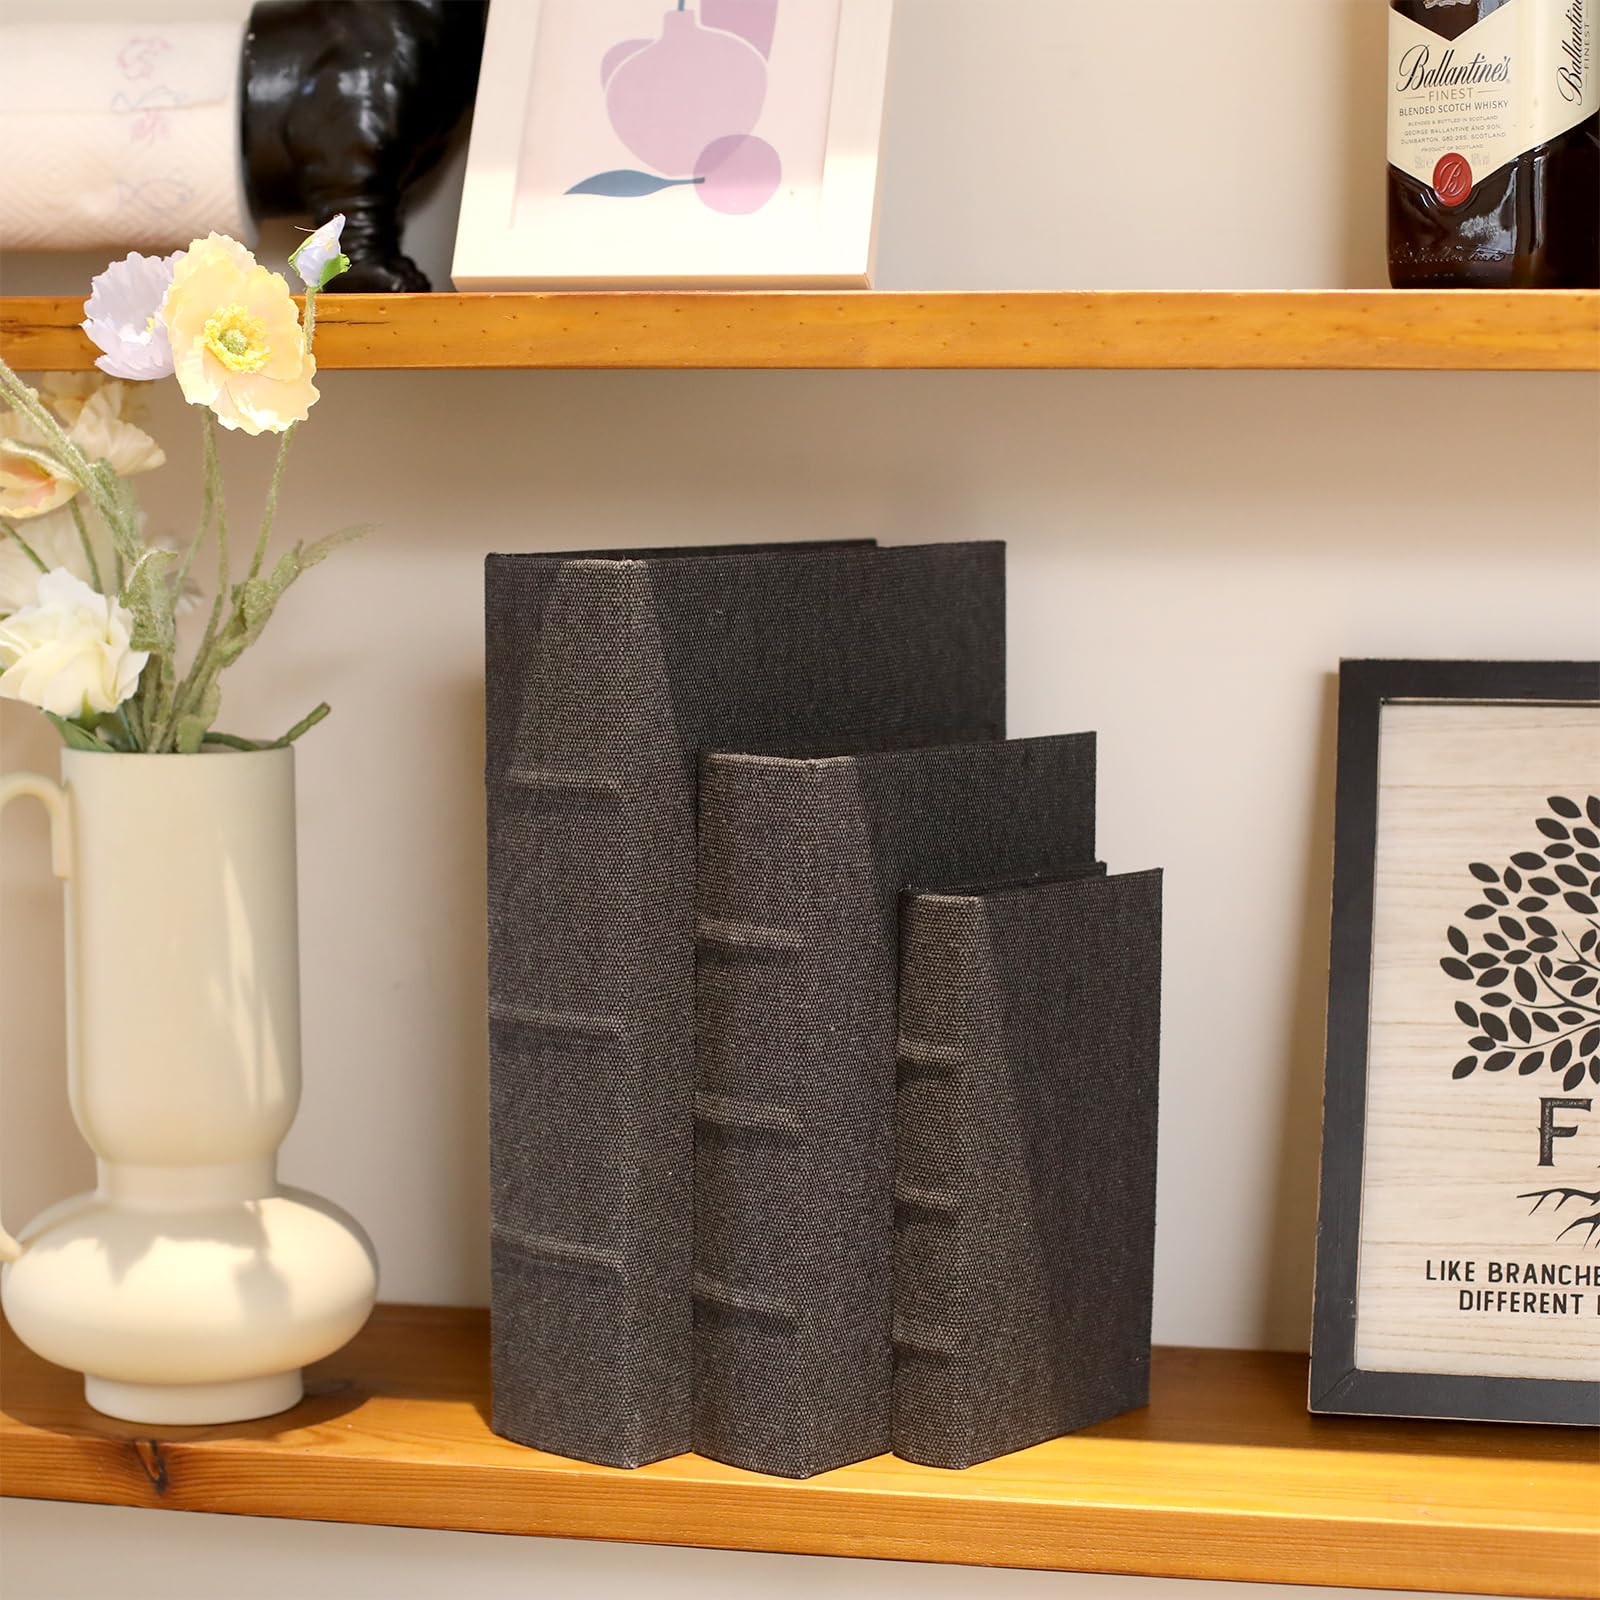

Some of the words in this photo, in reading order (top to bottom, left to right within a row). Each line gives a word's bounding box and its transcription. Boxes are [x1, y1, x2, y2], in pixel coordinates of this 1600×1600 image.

[1396, 44, 1511, 92] Ballantine's
[1429, 88, 1474, 101] FINEST
[1400, 105, 1435, 116] BLENDED
[1438, 102, 1471, 113] SCOTCH
[1475, 99, 1509, 111] WHISKY
[1430, 126, 1469, 134] BALLANTINE
[1537, 1097, 1600, 1167] F
[1426, 1260, 1475, 1282] LIKE
[1488, 1262, 1600, 1287] BRANCHE
[1459, 1290, 1584, 1315] DIFFERENT
